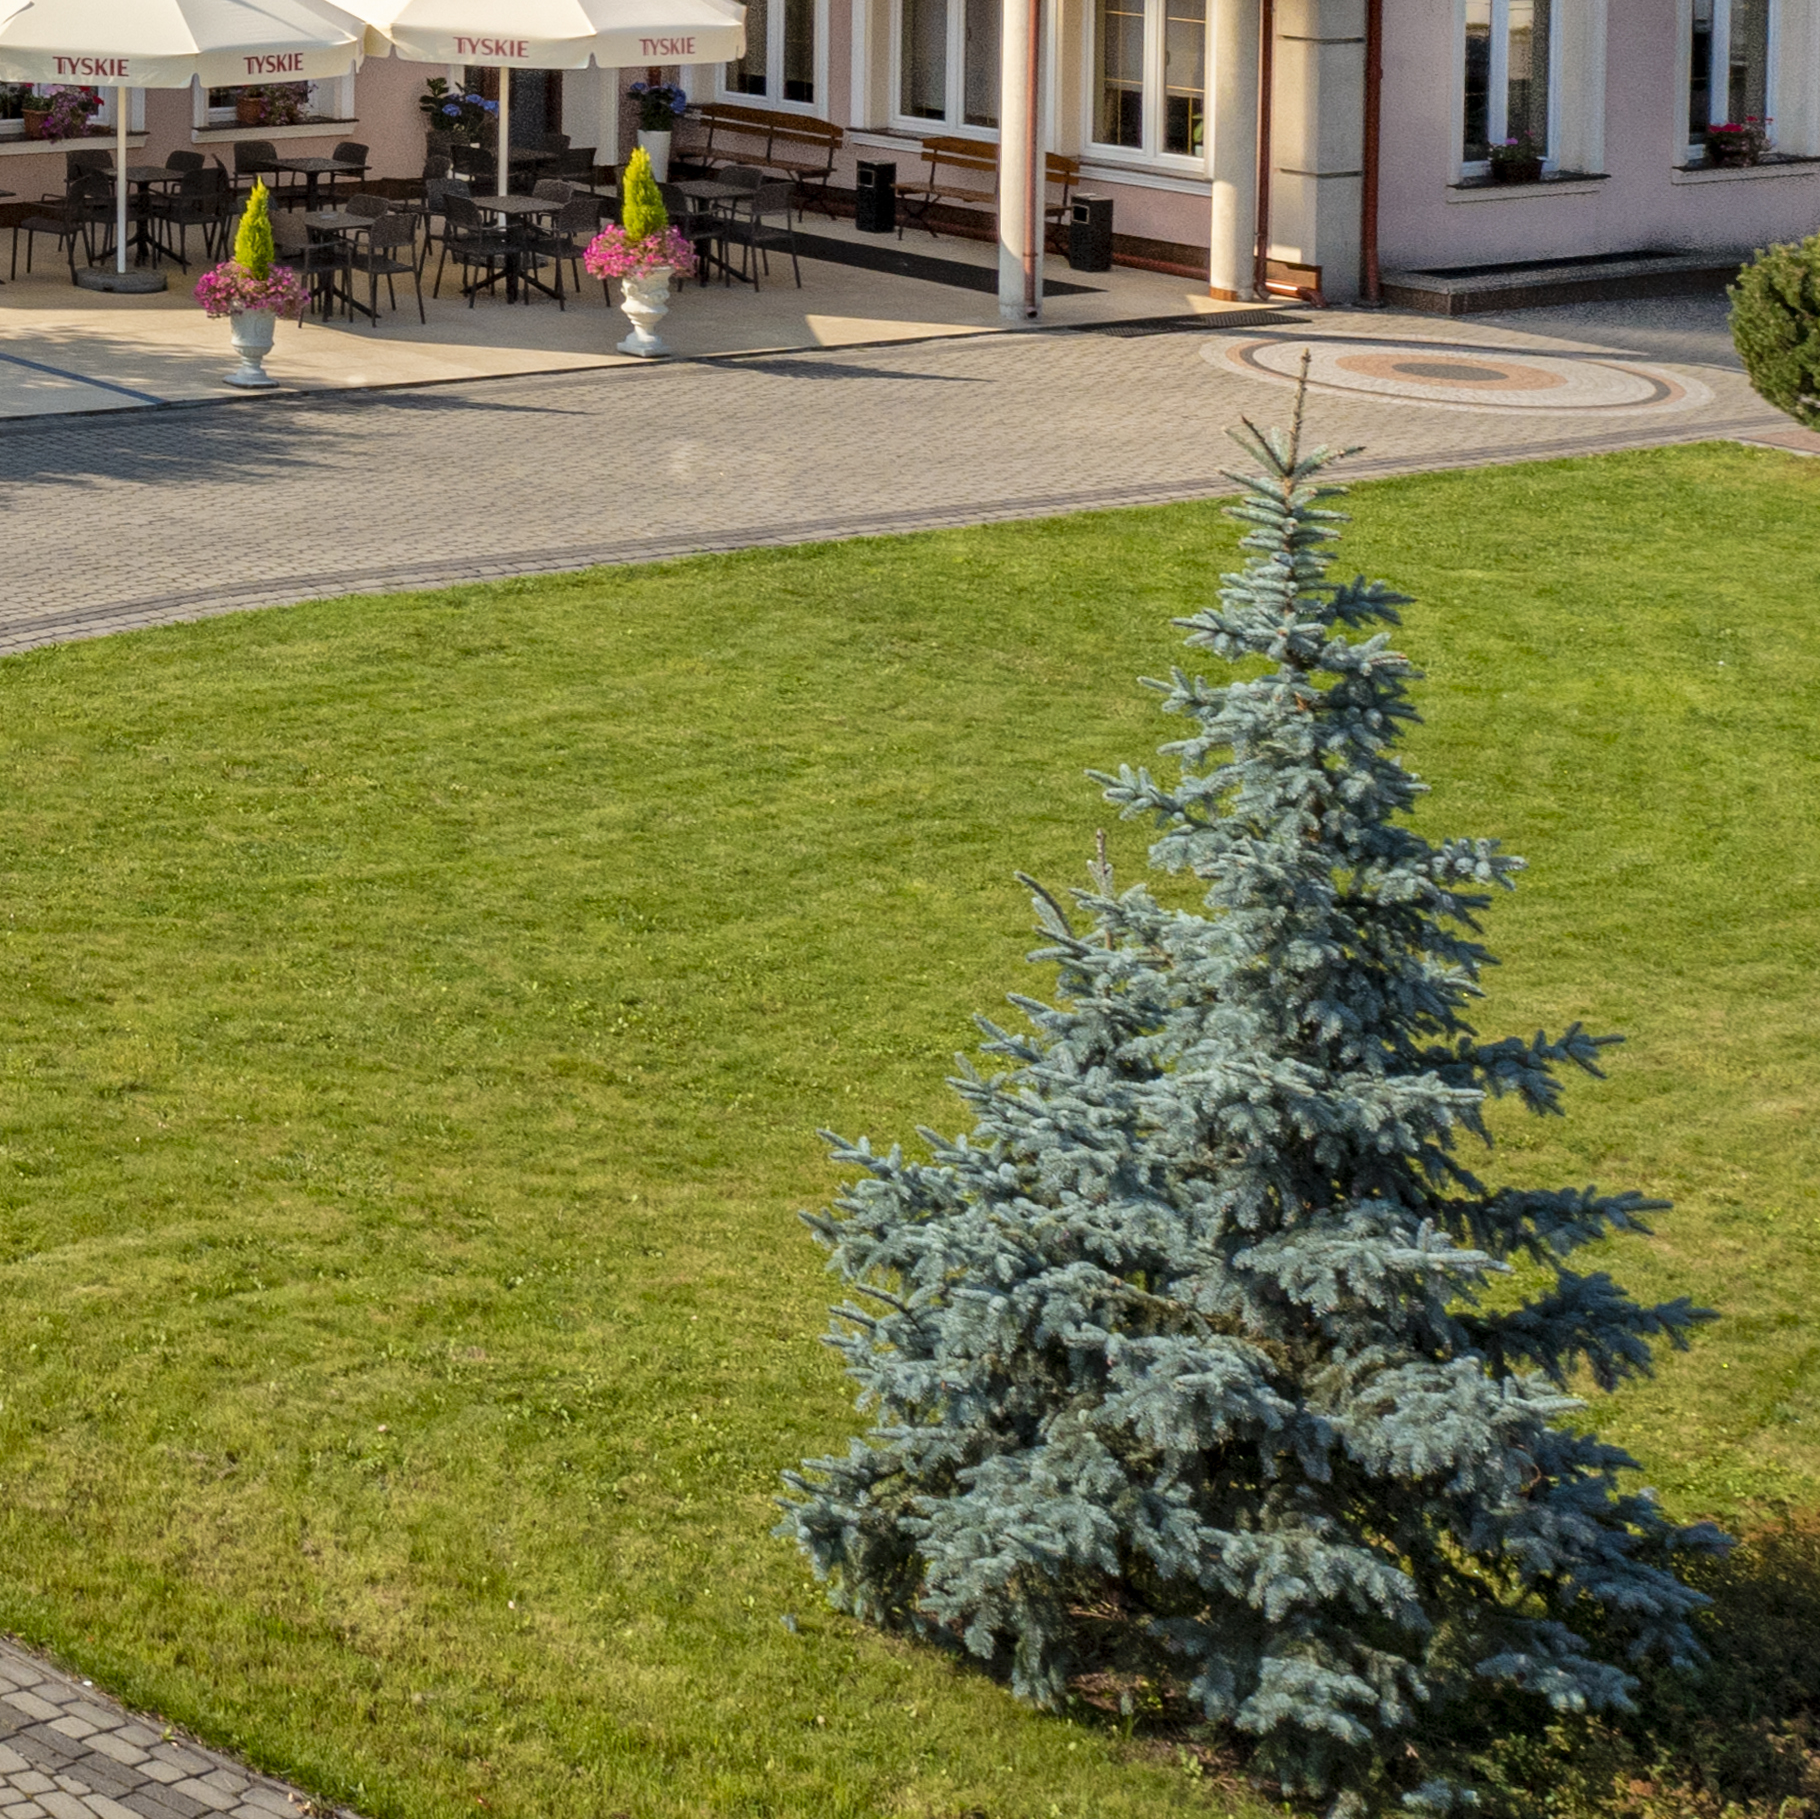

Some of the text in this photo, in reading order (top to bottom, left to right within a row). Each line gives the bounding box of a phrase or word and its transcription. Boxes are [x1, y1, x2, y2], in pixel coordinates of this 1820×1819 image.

[454, 36, 529, 58] TYSKIE
[639, 37, 695, 56] TYSKIE
[53, 56, 129, 77] TYSKIE
[243, 53, 304, 75] TYSKIE
